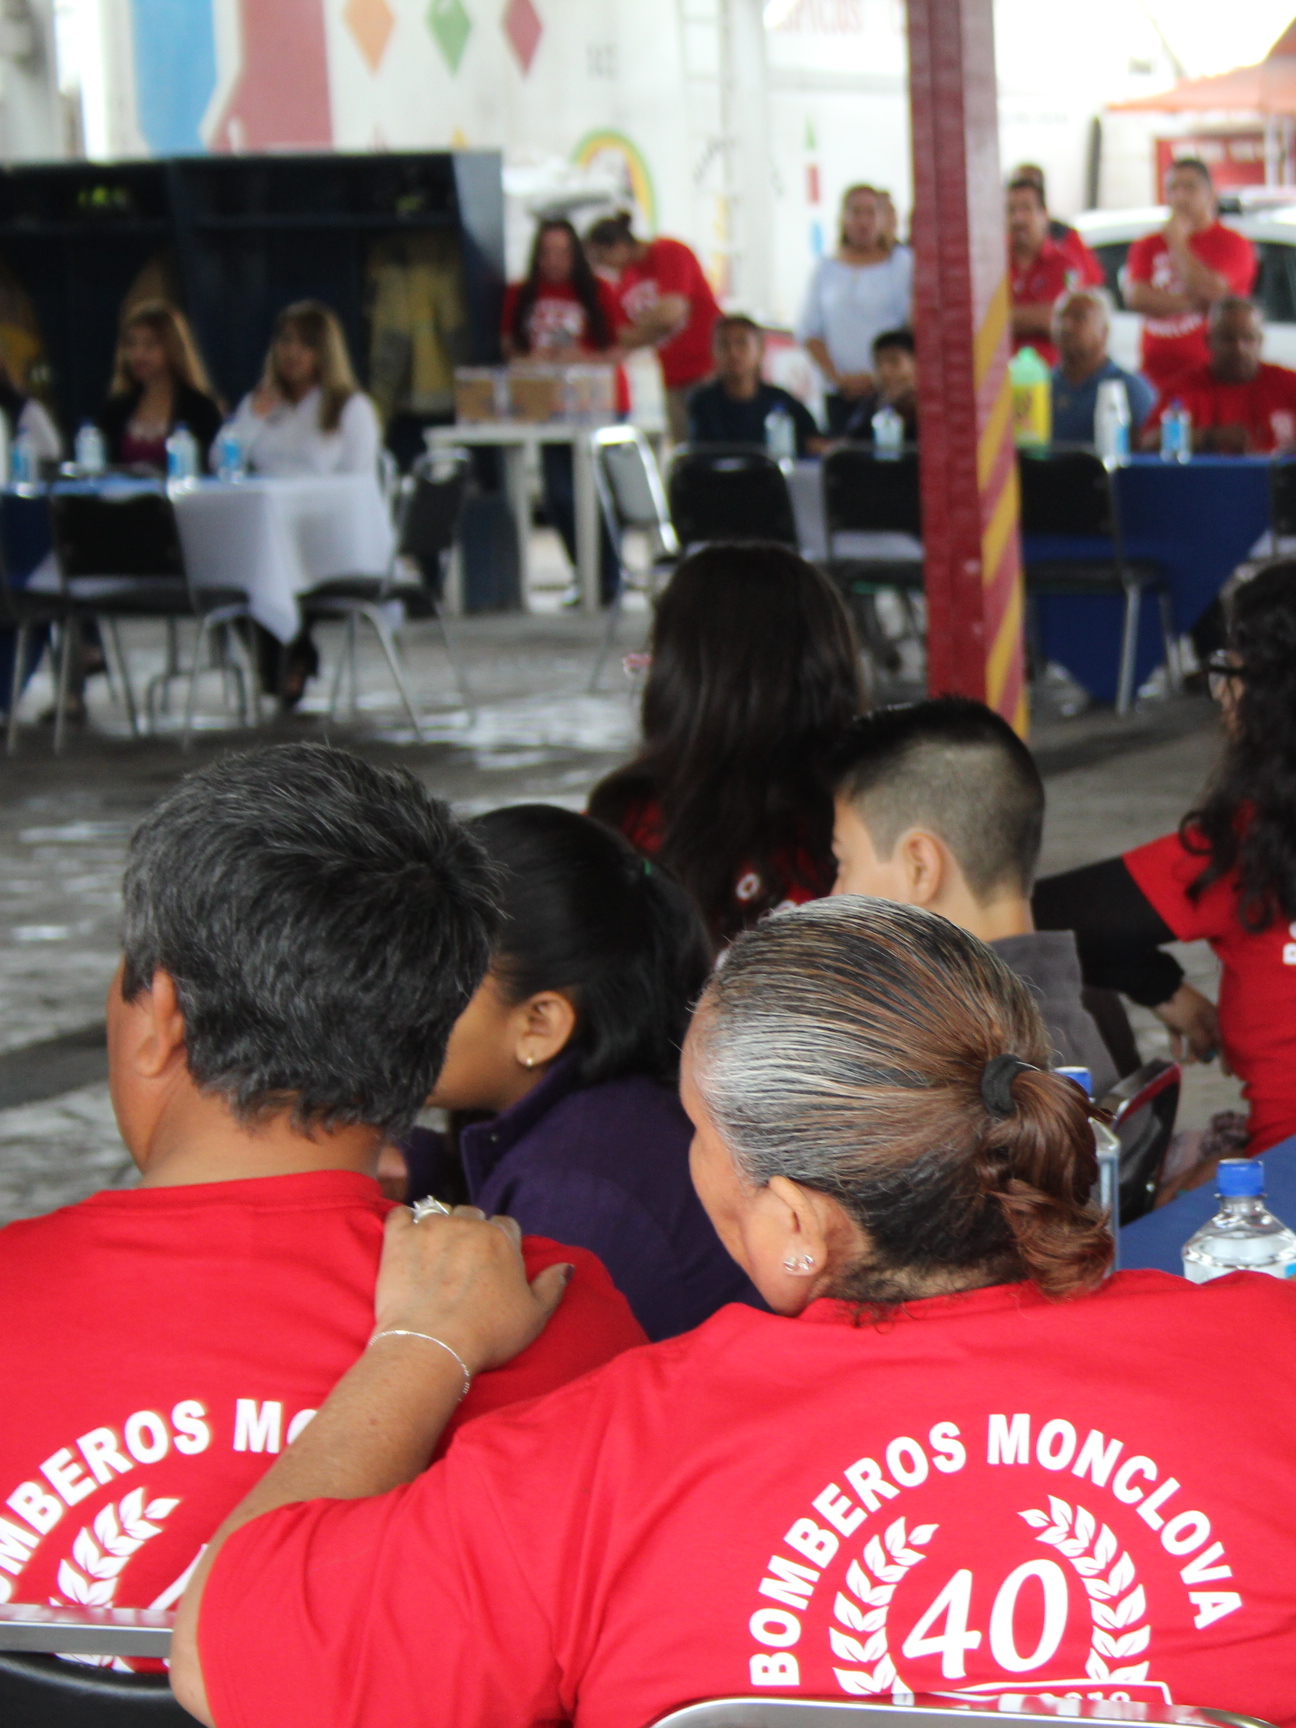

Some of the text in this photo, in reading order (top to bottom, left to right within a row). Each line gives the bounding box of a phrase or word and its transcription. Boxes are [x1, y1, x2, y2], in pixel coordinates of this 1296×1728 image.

[0, 1400, 210, 1602] MBEROS
[749, 1412, 1243, 1686] BOMBEROS MONCLOVA
[901, 1558, 1069, 1680] 40
